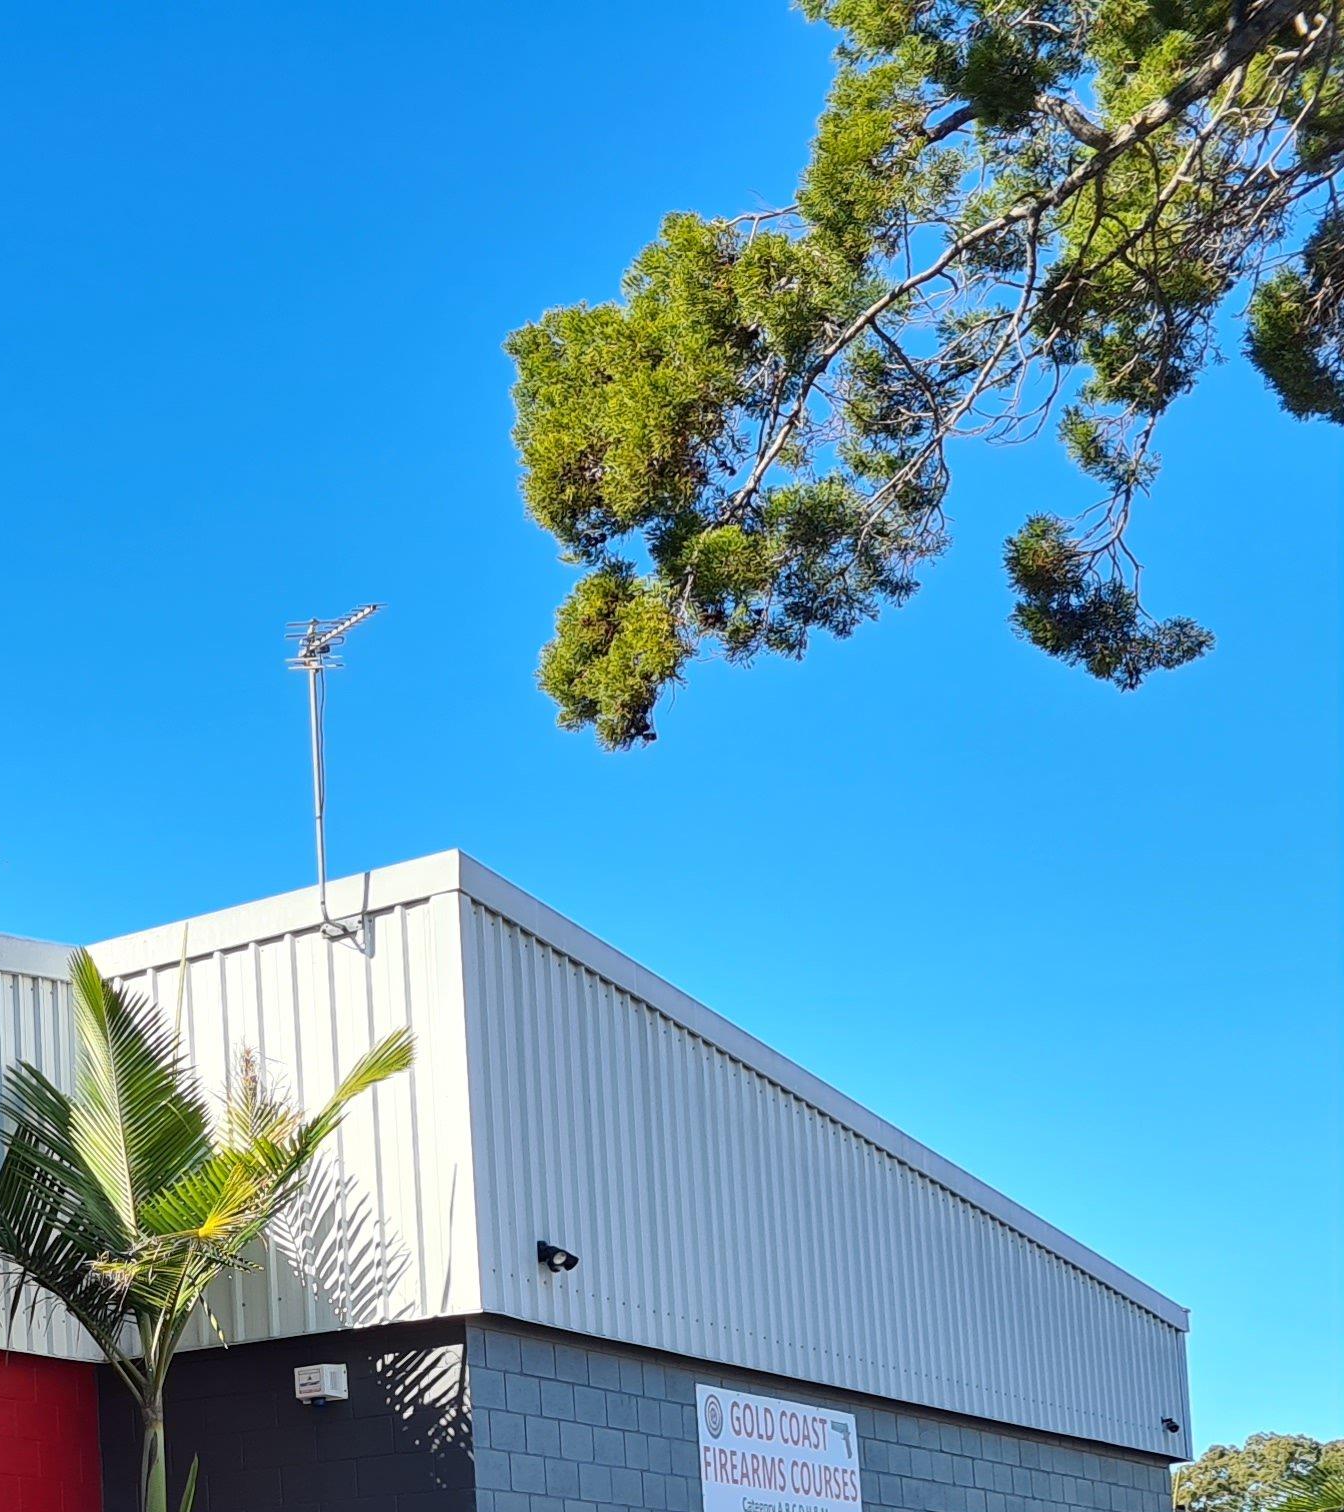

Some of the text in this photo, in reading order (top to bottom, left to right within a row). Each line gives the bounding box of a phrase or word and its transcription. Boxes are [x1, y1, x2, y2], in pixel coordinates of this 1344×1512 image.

[730, 1401, 827, 1450] GOLD COAST
[703, 1446, 859, 1502] FIREARMS COURSES
